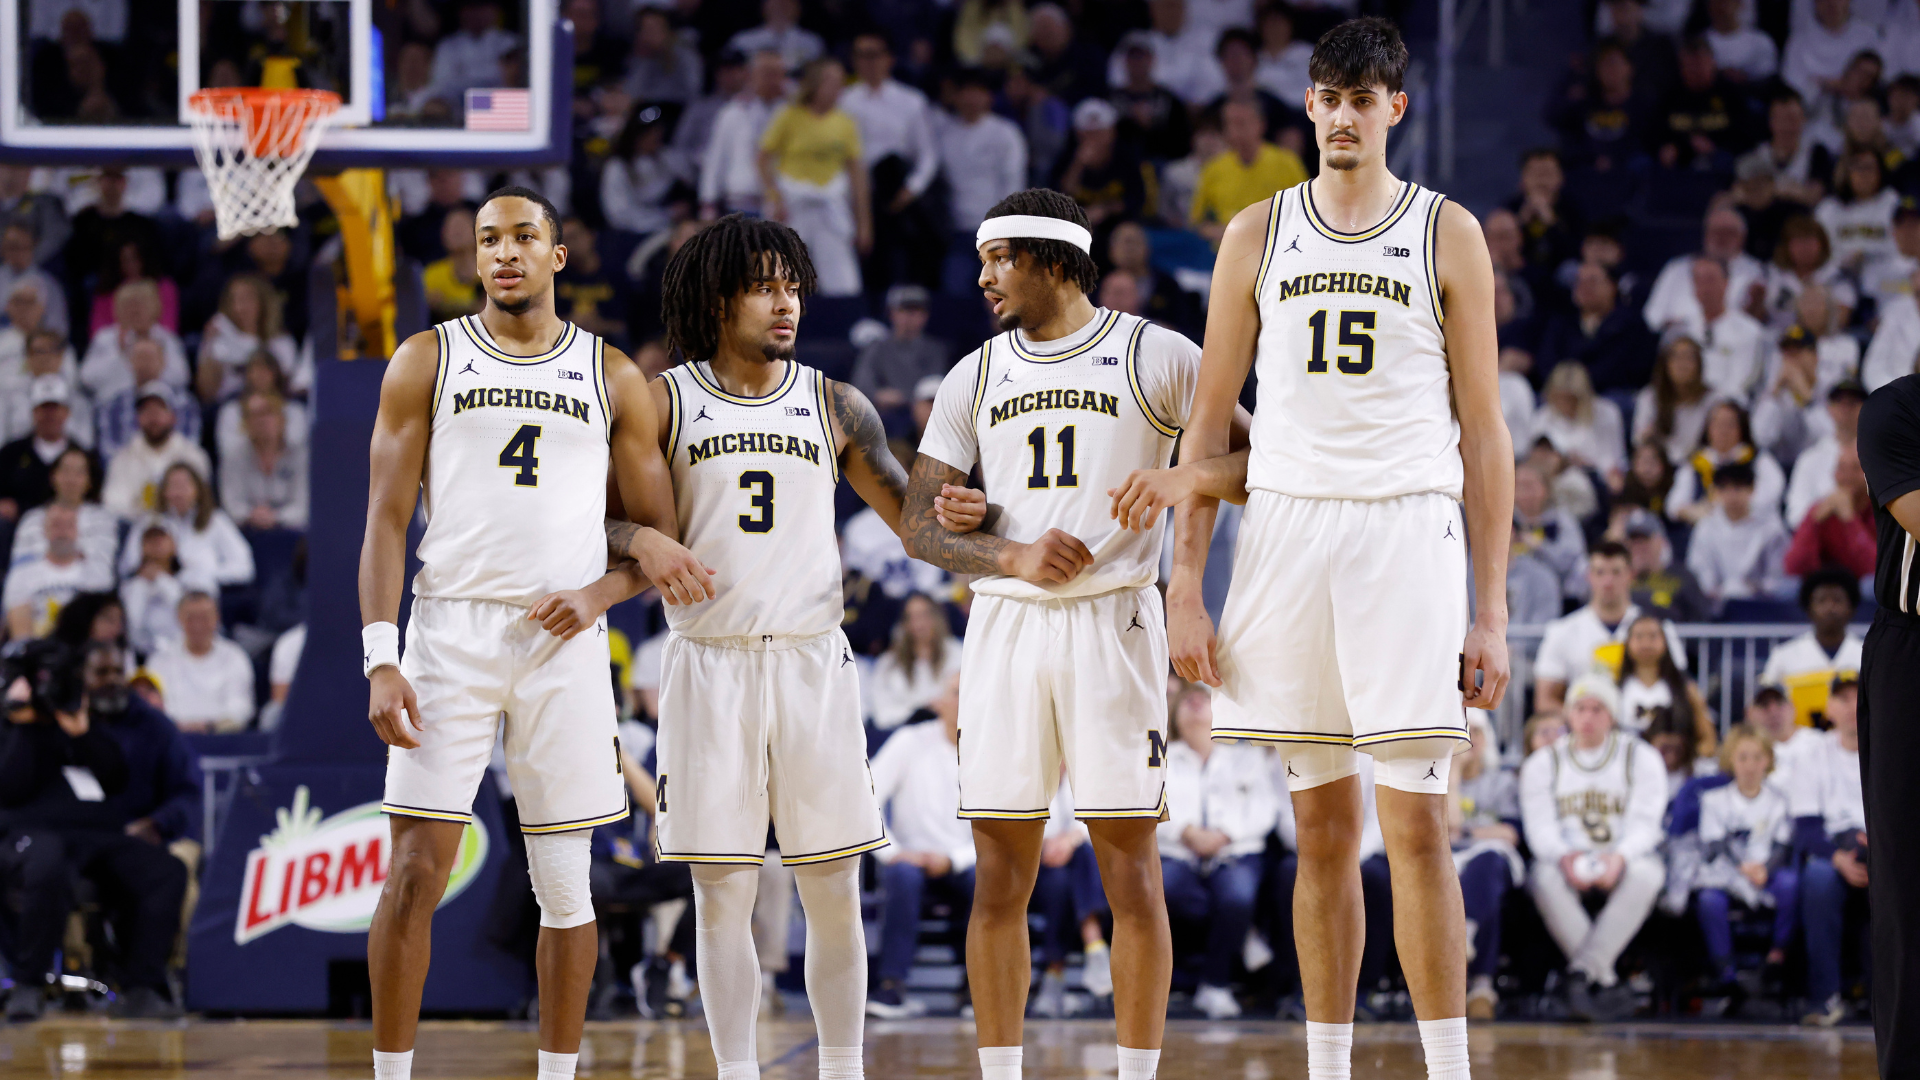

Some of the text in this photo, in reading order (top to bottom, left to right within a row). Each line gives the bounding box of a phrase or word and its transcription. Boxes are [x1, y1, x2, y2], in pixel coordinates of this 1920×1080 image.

[1279, 271, 1412, 308] MICHIGAN
[1307, 308, 1377, 376] 15
[453, 387, 590, 425] MICHIGAN
[990, 388, 1119, 429] MICHIGAN
[498, 423, 542, 488] 4
[687, 432, 820, 467] MICHIGAN
[1027, 424, 1079, 490] 11
[737, 469, 775, 534] 3
[1147, 729, 1168, 769] M
[245, 837, 389, 930] LIBM
